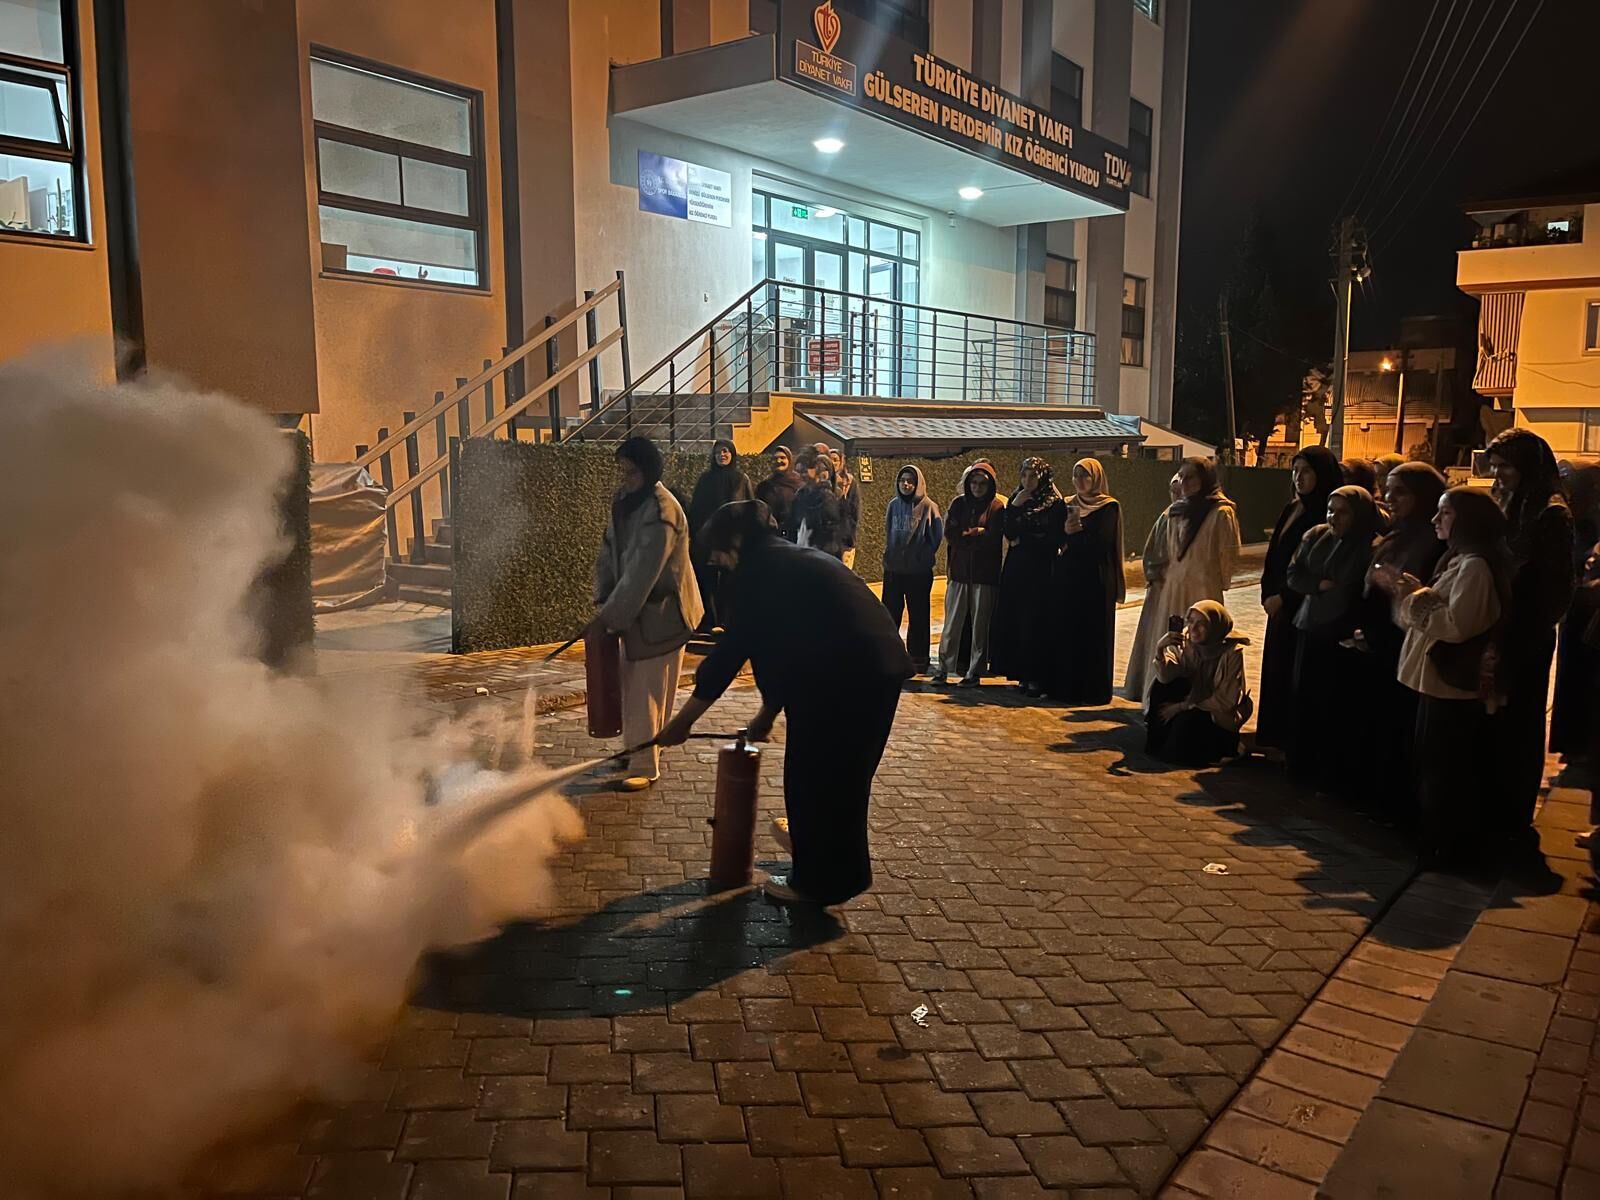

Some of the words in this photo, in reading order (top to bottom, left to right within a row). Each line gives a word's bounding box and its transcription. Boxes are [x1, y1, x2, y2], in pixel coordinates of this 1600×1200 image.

[799, 59, 831, 82] DİYANET
[832, 73, 853, 91] VAKFI
[811, 50, 842, 74] TÜRKİYE
[913, 53, 979, 108] TÜRKİYE
[981, 86, 1036, 132] DİYANET
[1038, 113, 1073, 149] VAKFI
[863, 70, 939, 124] GÜLSEREN
[941, 104, 1002, 150] PEKDEMİR
[1004, 132, 1023, 158] KIZ
[1024, 136, 1068, 176] ÖĞRENCİ
[1069, 159, 1100, 188] YURDU
[1104, 151, 1127, 182] TDV
